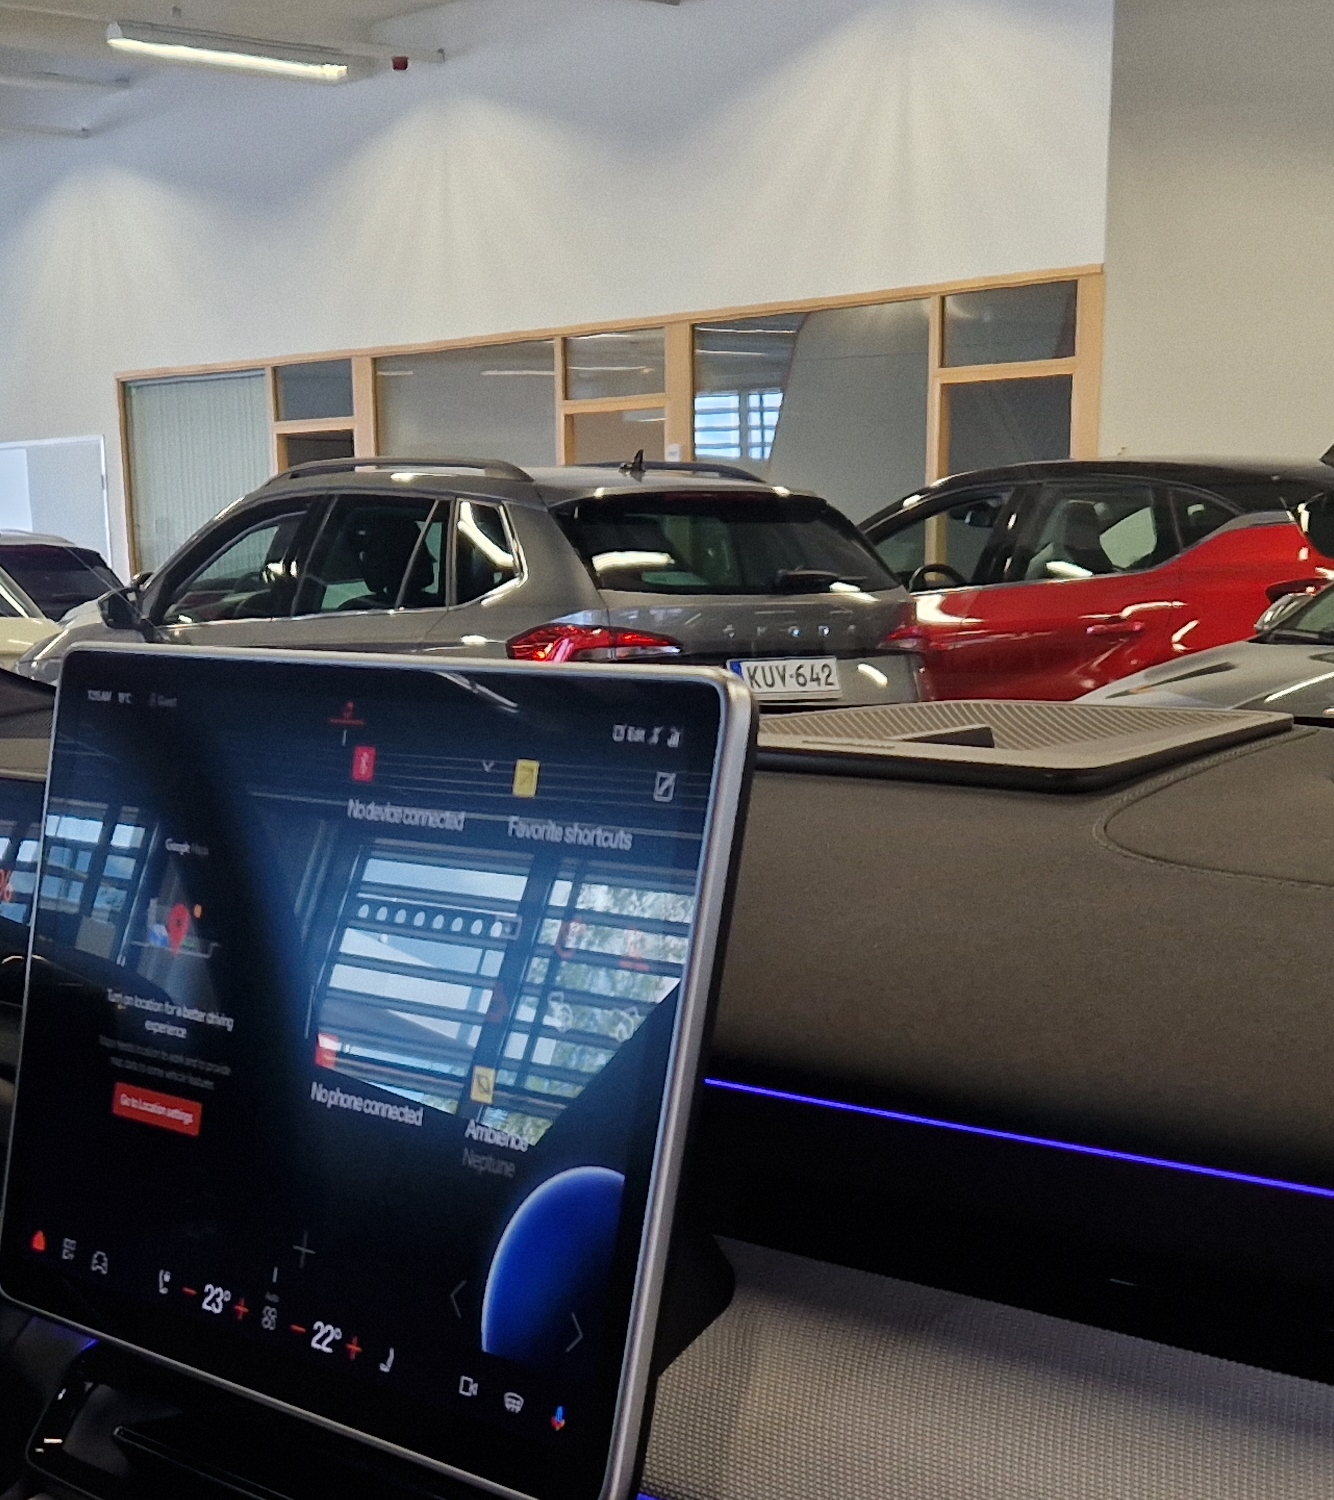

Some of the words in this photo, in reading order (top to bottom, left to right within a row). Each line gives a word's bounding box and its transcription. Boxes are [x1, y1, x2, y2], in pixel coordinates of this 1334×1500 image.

[747, 663, 836, 689] KUV-642
[347, 799, 365, 819] No
[366, 802, 402, 825] device
[403, 807, 466, 832] connected
[508, 815, 564, 842] Favorite
[564, 822, 632, 850] shortcuts
[311, 1081, 330, 1102] No
[328, 1087, 363, 1110] phone
[364, 1098, 423, 1127] connected
[465, 1118, 528, 1152] Ambience
[462, 1148, 515, 1178] Neptune
[202, 1283, 231, 1314] 23°
[310, 1321, 342, 1353] 22°
